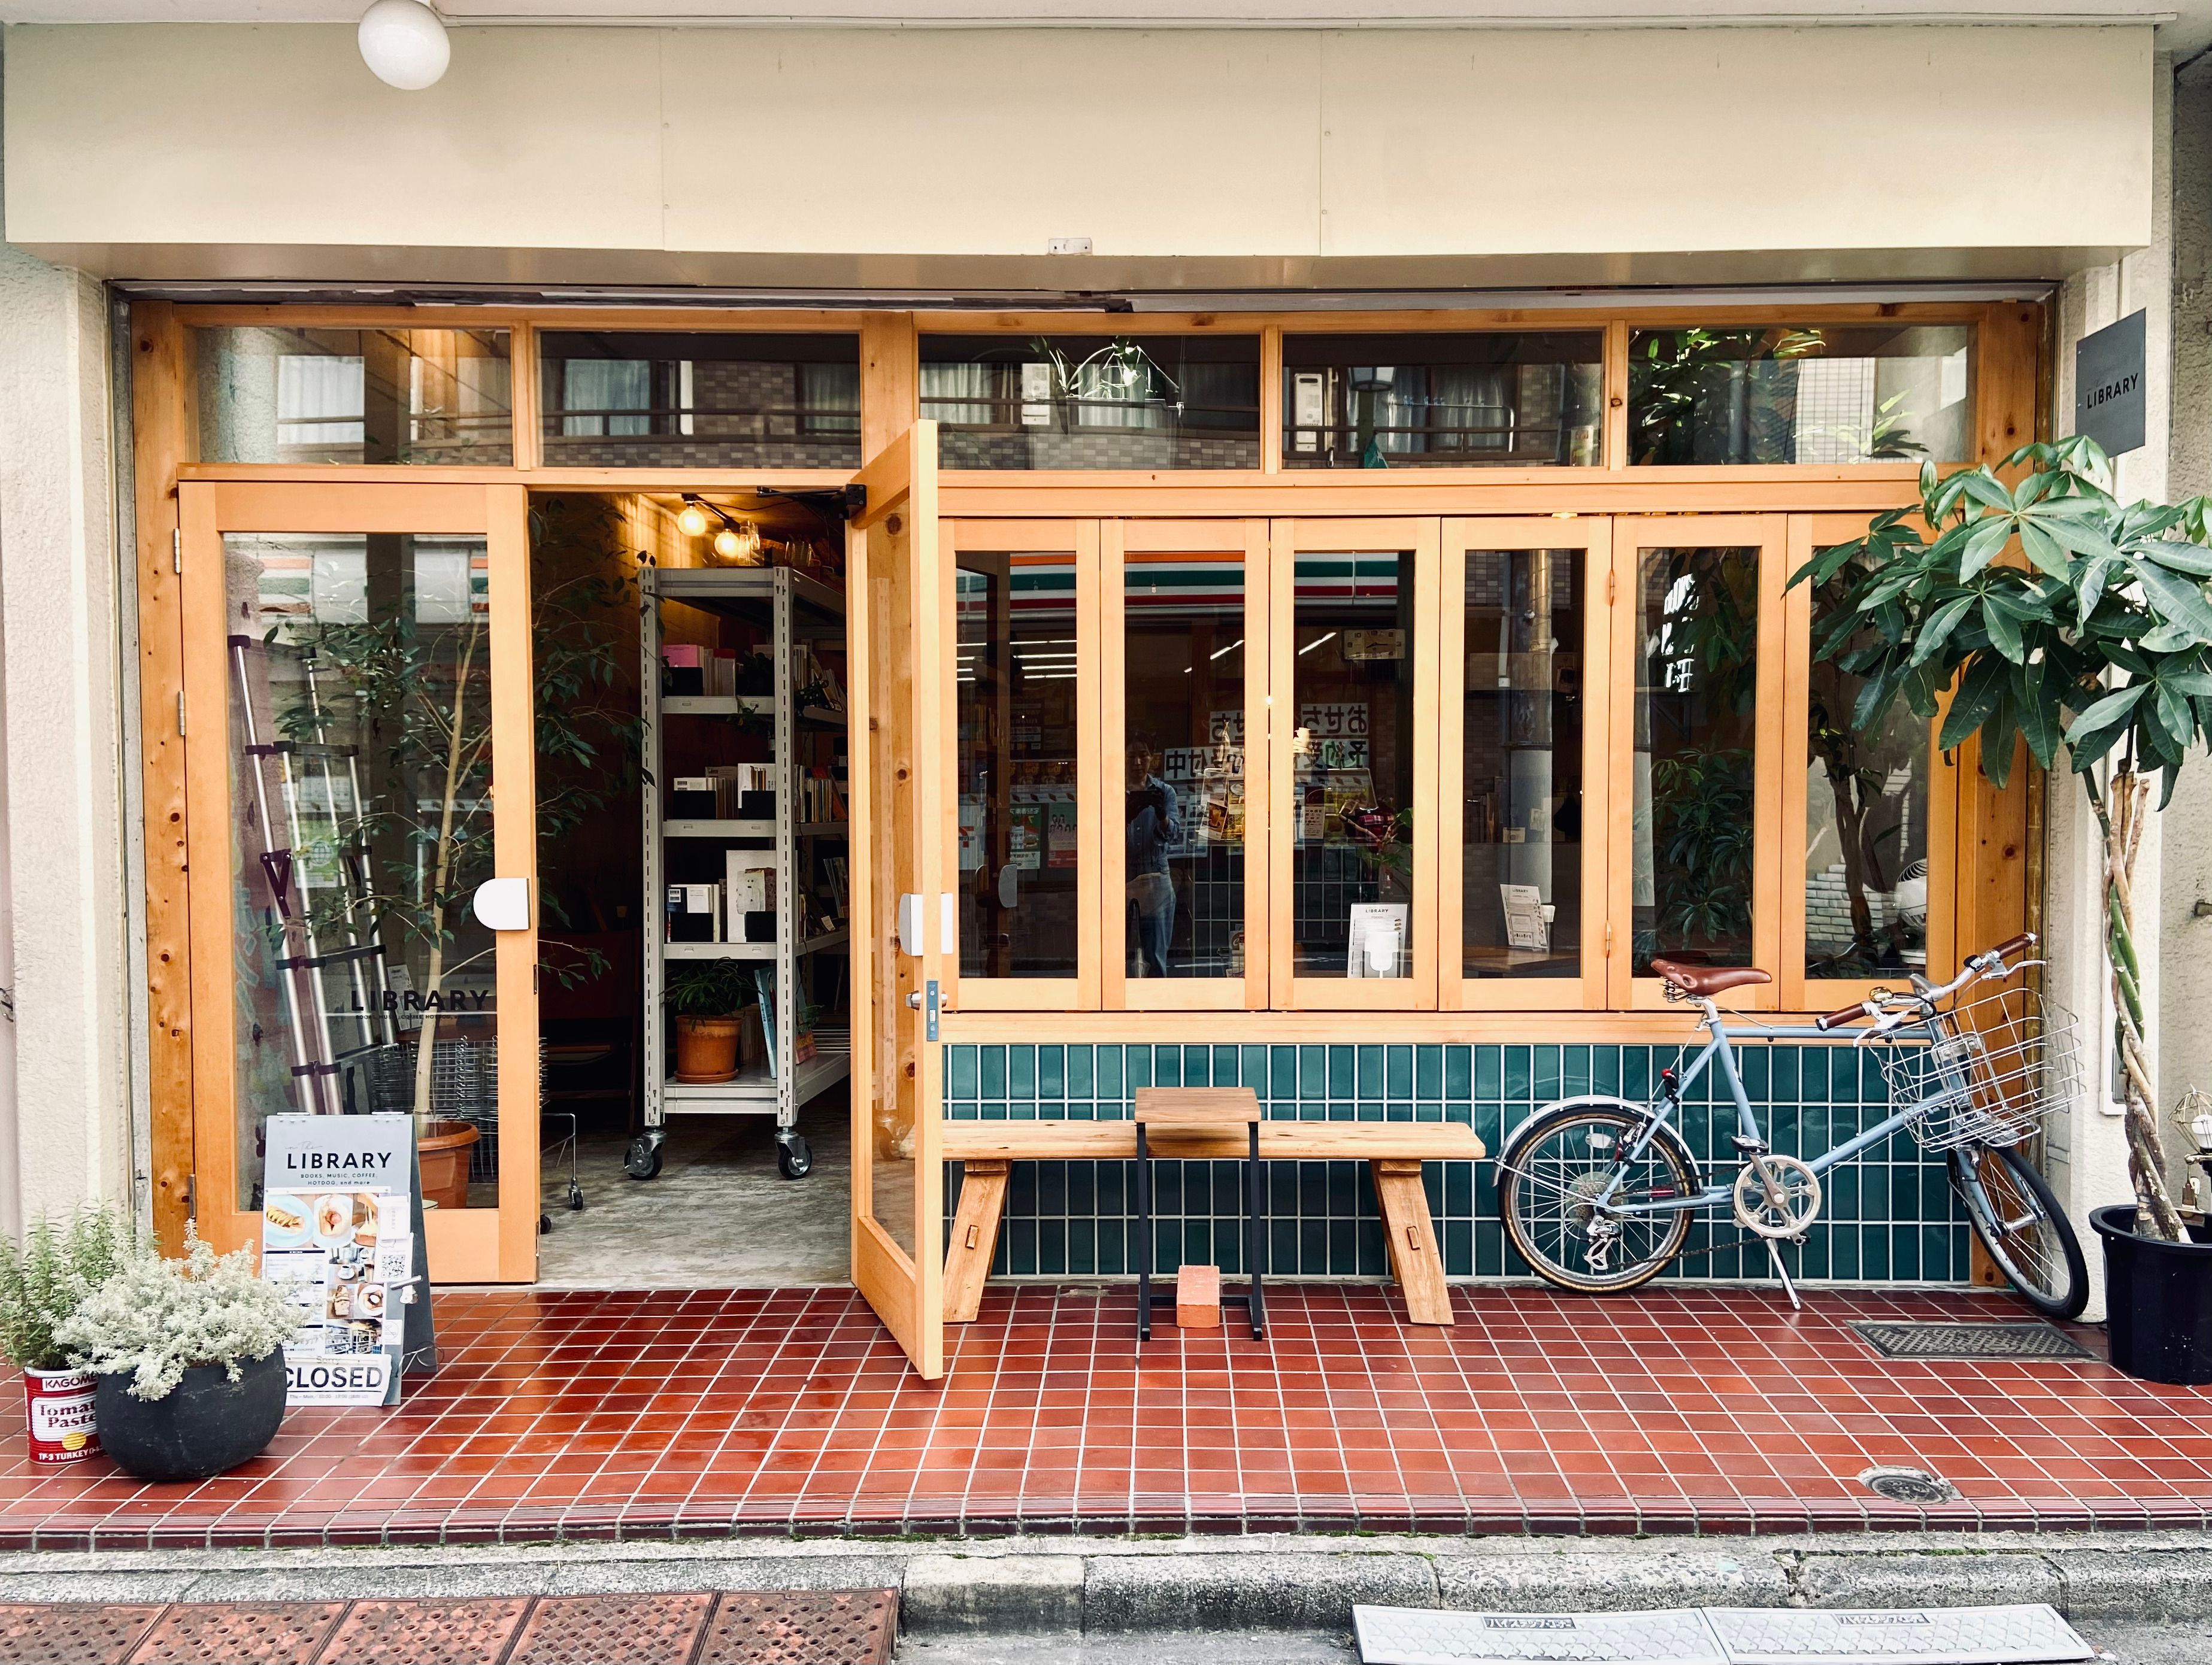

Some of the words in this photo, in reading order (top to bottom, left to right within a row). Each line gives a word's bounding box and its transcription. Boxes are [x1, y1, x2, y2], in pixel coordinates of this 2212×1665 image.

[2087, 372, 2138, 410] LIBRARY
[351, 990, 489, 1011] LIBRARY
[287, 1153, 392, 1169] LIBRARY
[46, 1375, 97, 1388] KAGOME
[38, 1400, 96, 1416] Tomat
[48, 1414, 96, 1428] Paste
[54, 1449, 88, 1460] TURKEY
